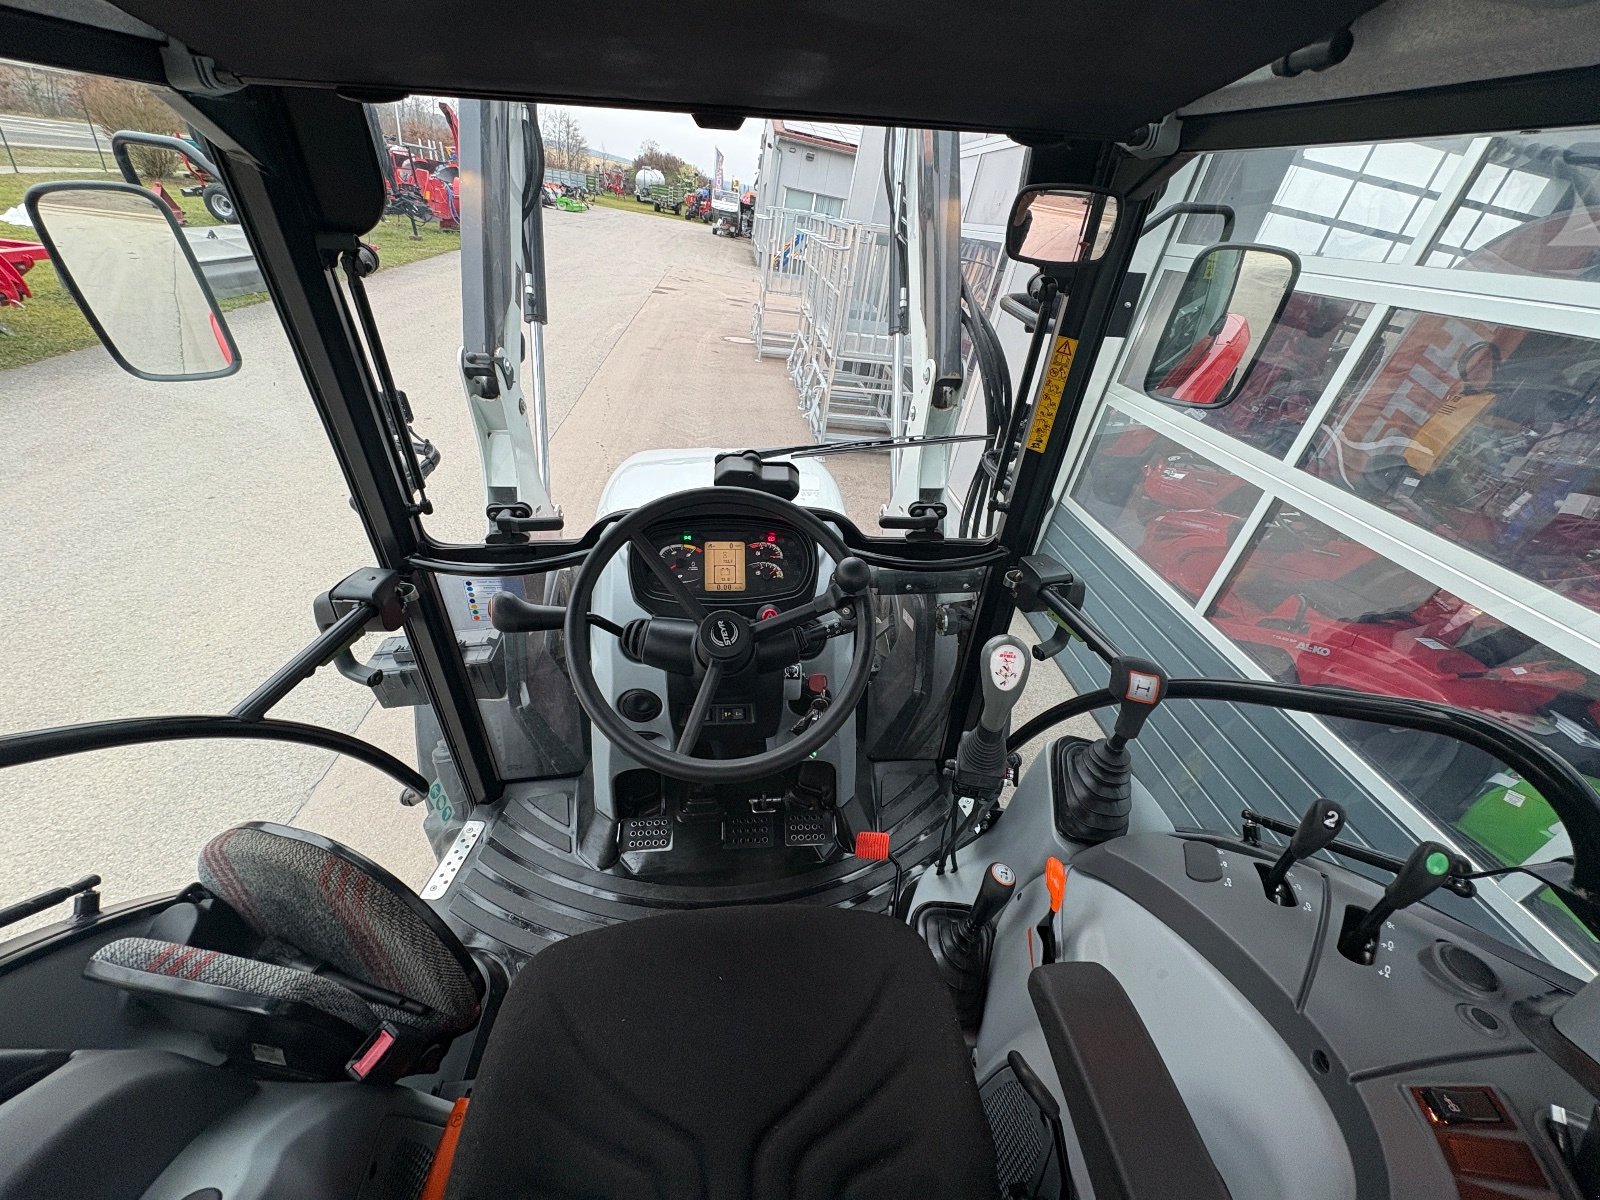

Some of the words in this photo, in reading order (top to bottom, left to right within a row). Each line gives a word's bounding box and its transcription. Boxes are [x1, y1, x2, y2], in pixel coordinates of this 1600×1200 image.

[717, 620, 732, 646] STEYR
[1296, 642, 1331, 657] AL-KO
[1323, 810, 1339, 828] 2
